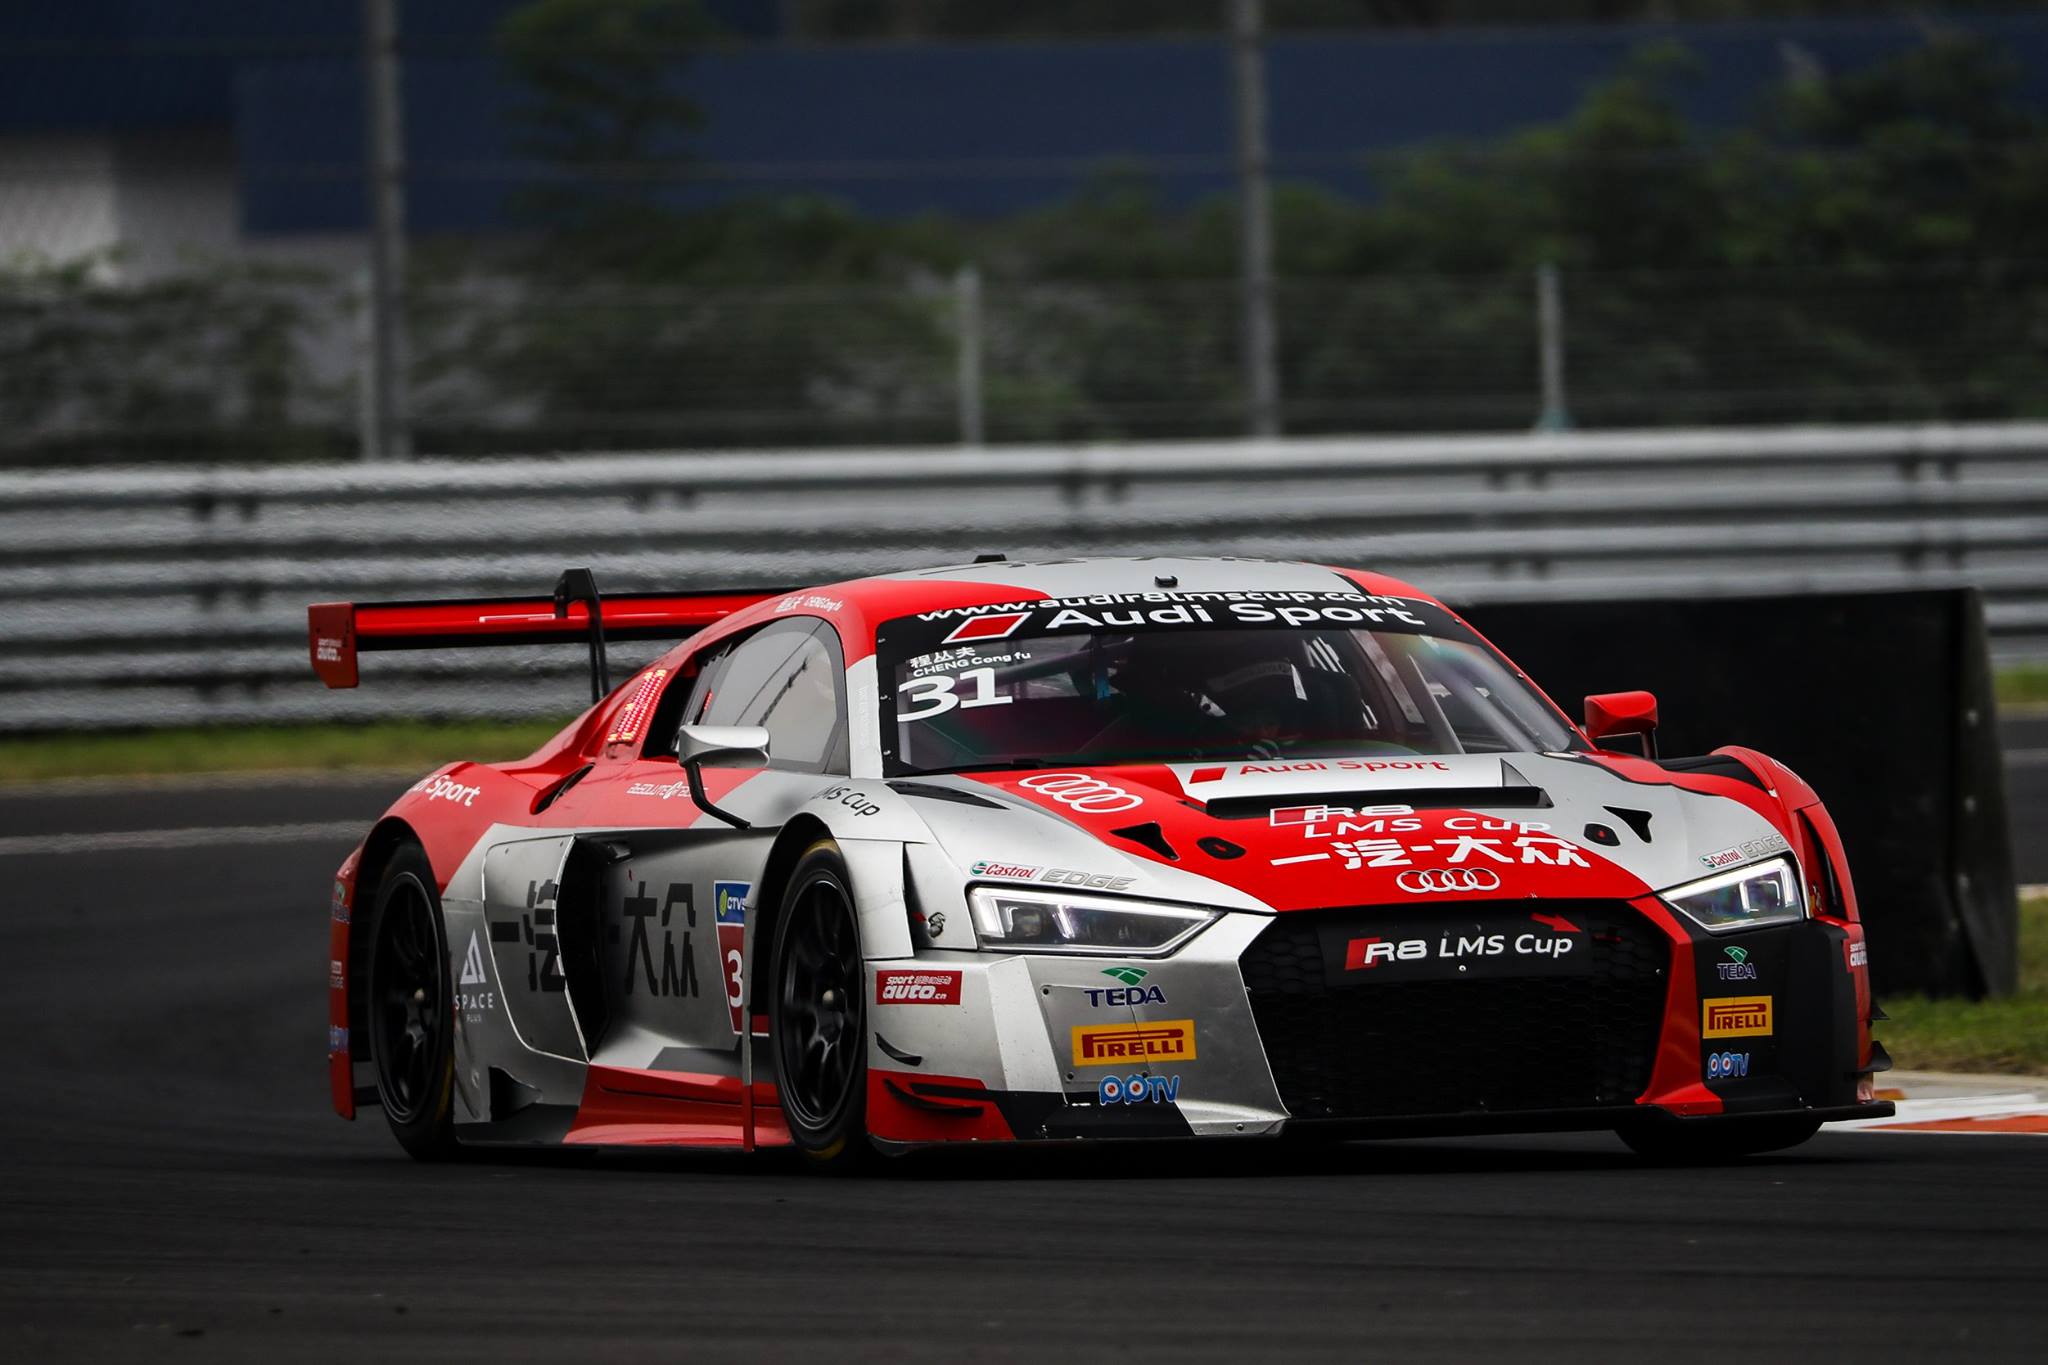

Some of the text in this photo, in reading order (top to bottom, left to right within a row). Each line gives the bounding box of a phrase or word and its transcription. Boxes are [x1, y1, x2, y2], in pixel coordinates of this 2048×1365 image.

[917, 591, 1406, 622] www.audir8lmscup.com
[1045, 603, 1426, 629] Audi Sport
[909, 647, 976, 669] 程丛夫
[913, 651, 1032, 678] CHENG Cong fu
[897, 667, 1013, 723] 31
[1239, 760, 1450, 776] Audi Sport
[425, 774, 481, 807] Sport
[841, 792, 881, 817] Cup
[1303, 804, 1415, 821] R8
[1305, 817, 1551, 839] LMS Cup
[1710, 834, 1789, 867] Castrol EDGE
[983, 863, 1138, 891] Castrol EDGE
[1364, 933, 1574, 964] R8 LMS Cup
[886, 975, 915, 986] sport
[1717, 963, 1757, 980] TEDA
[454, 993, 494, 1010] SPACE
[1084, 985, 1168, 1008] TEDA
[1708, 1003, 1767, 1031] PIRELLI
[1082, 1028, 1184, 1058] PIRELLI
